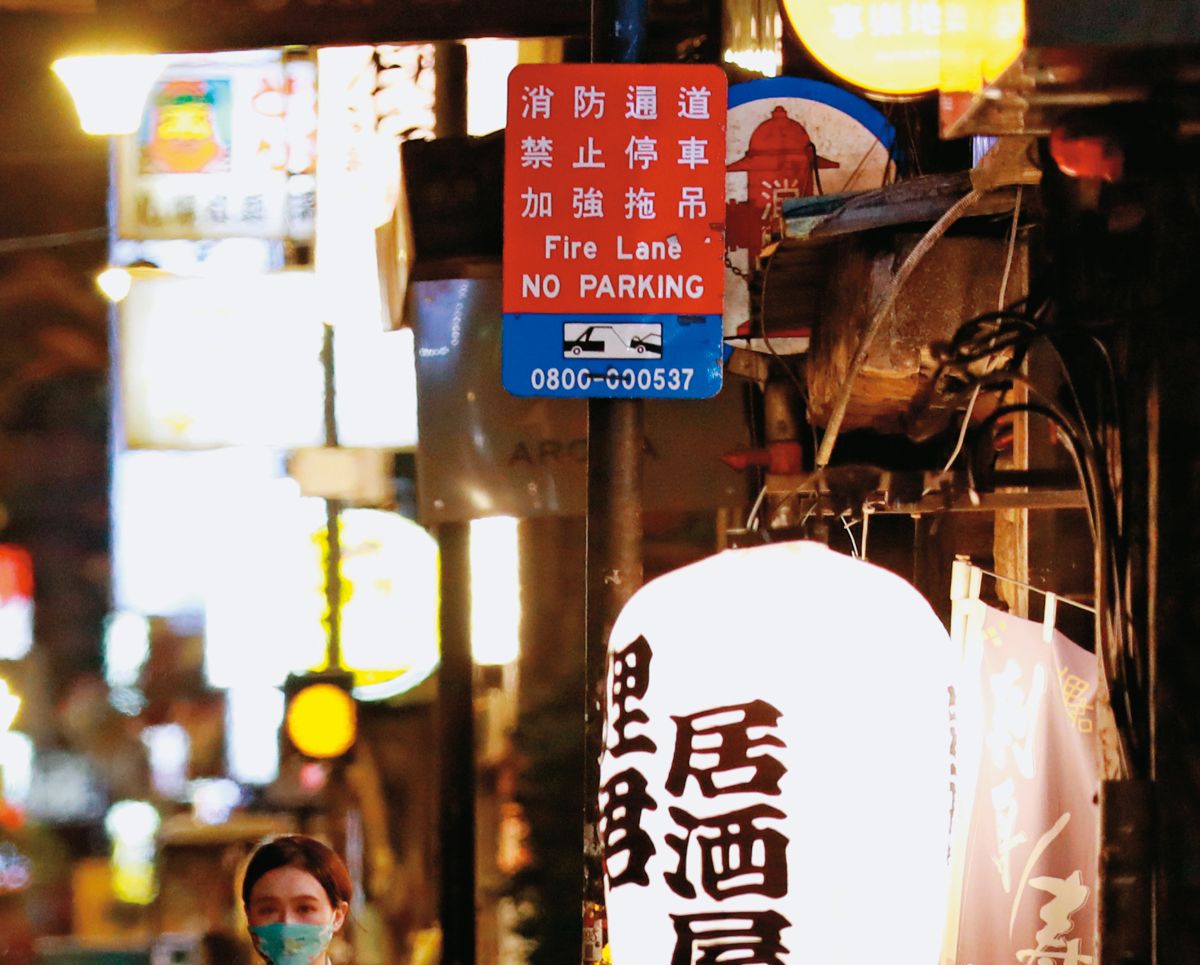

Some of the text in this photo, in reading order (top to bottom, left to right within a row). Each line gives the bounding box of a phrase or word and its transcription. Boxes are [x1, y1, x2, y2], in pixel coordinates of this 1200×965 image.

[521, 85, 711, 120] 消防通道
[520, 135, 709, 170] 禁止停車
[520, 186, 708, 220] 加強拖吊
[545, 235, 682, 260] Fire Lane
[522, 274, 704, 299] NO PARKING
[531, 367, 695, 391] 0800-000537
